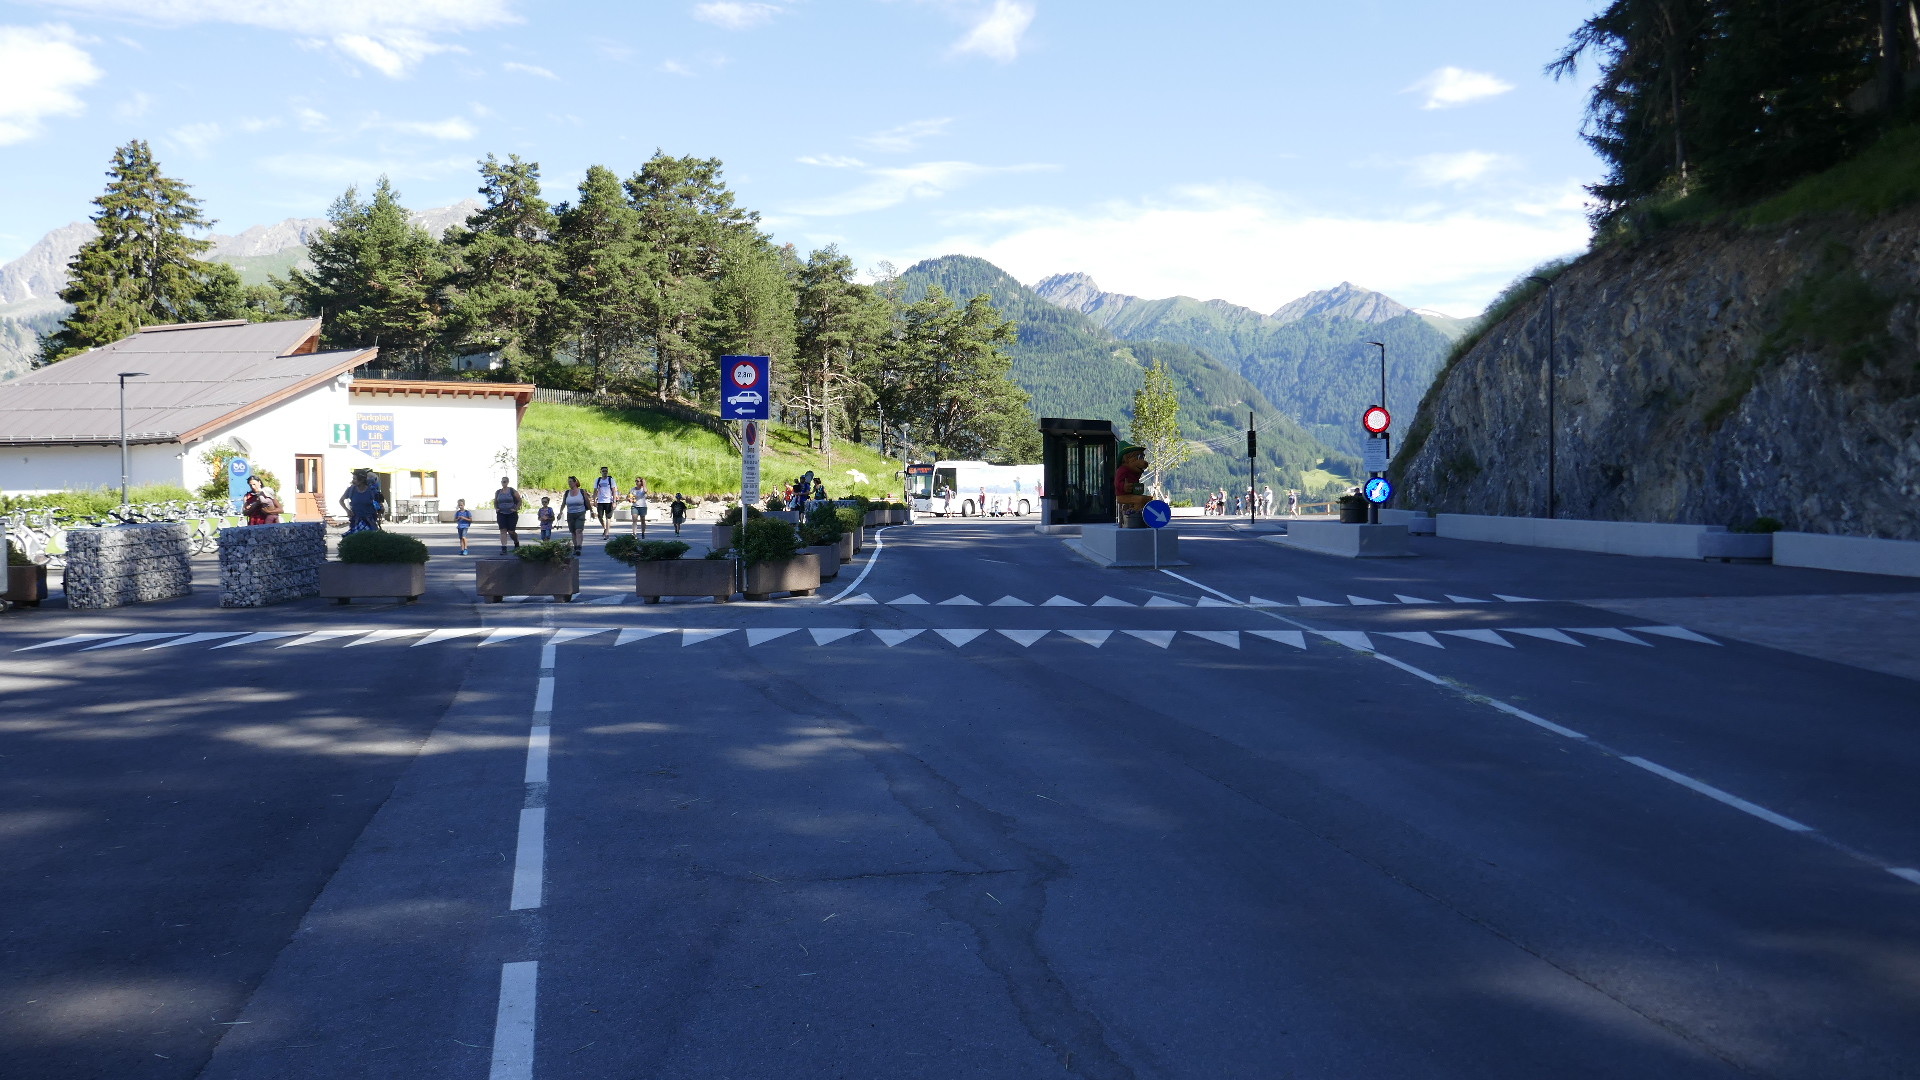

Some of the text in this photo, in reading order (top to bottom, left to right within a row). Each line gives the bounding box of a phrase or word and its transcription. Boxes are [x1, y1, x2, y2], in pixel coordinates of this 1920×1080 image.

[356, 413, 394, 423] Parkplatz
[361, 423, 389, 432] Garage
[368, 432, 383, 440] Lift
